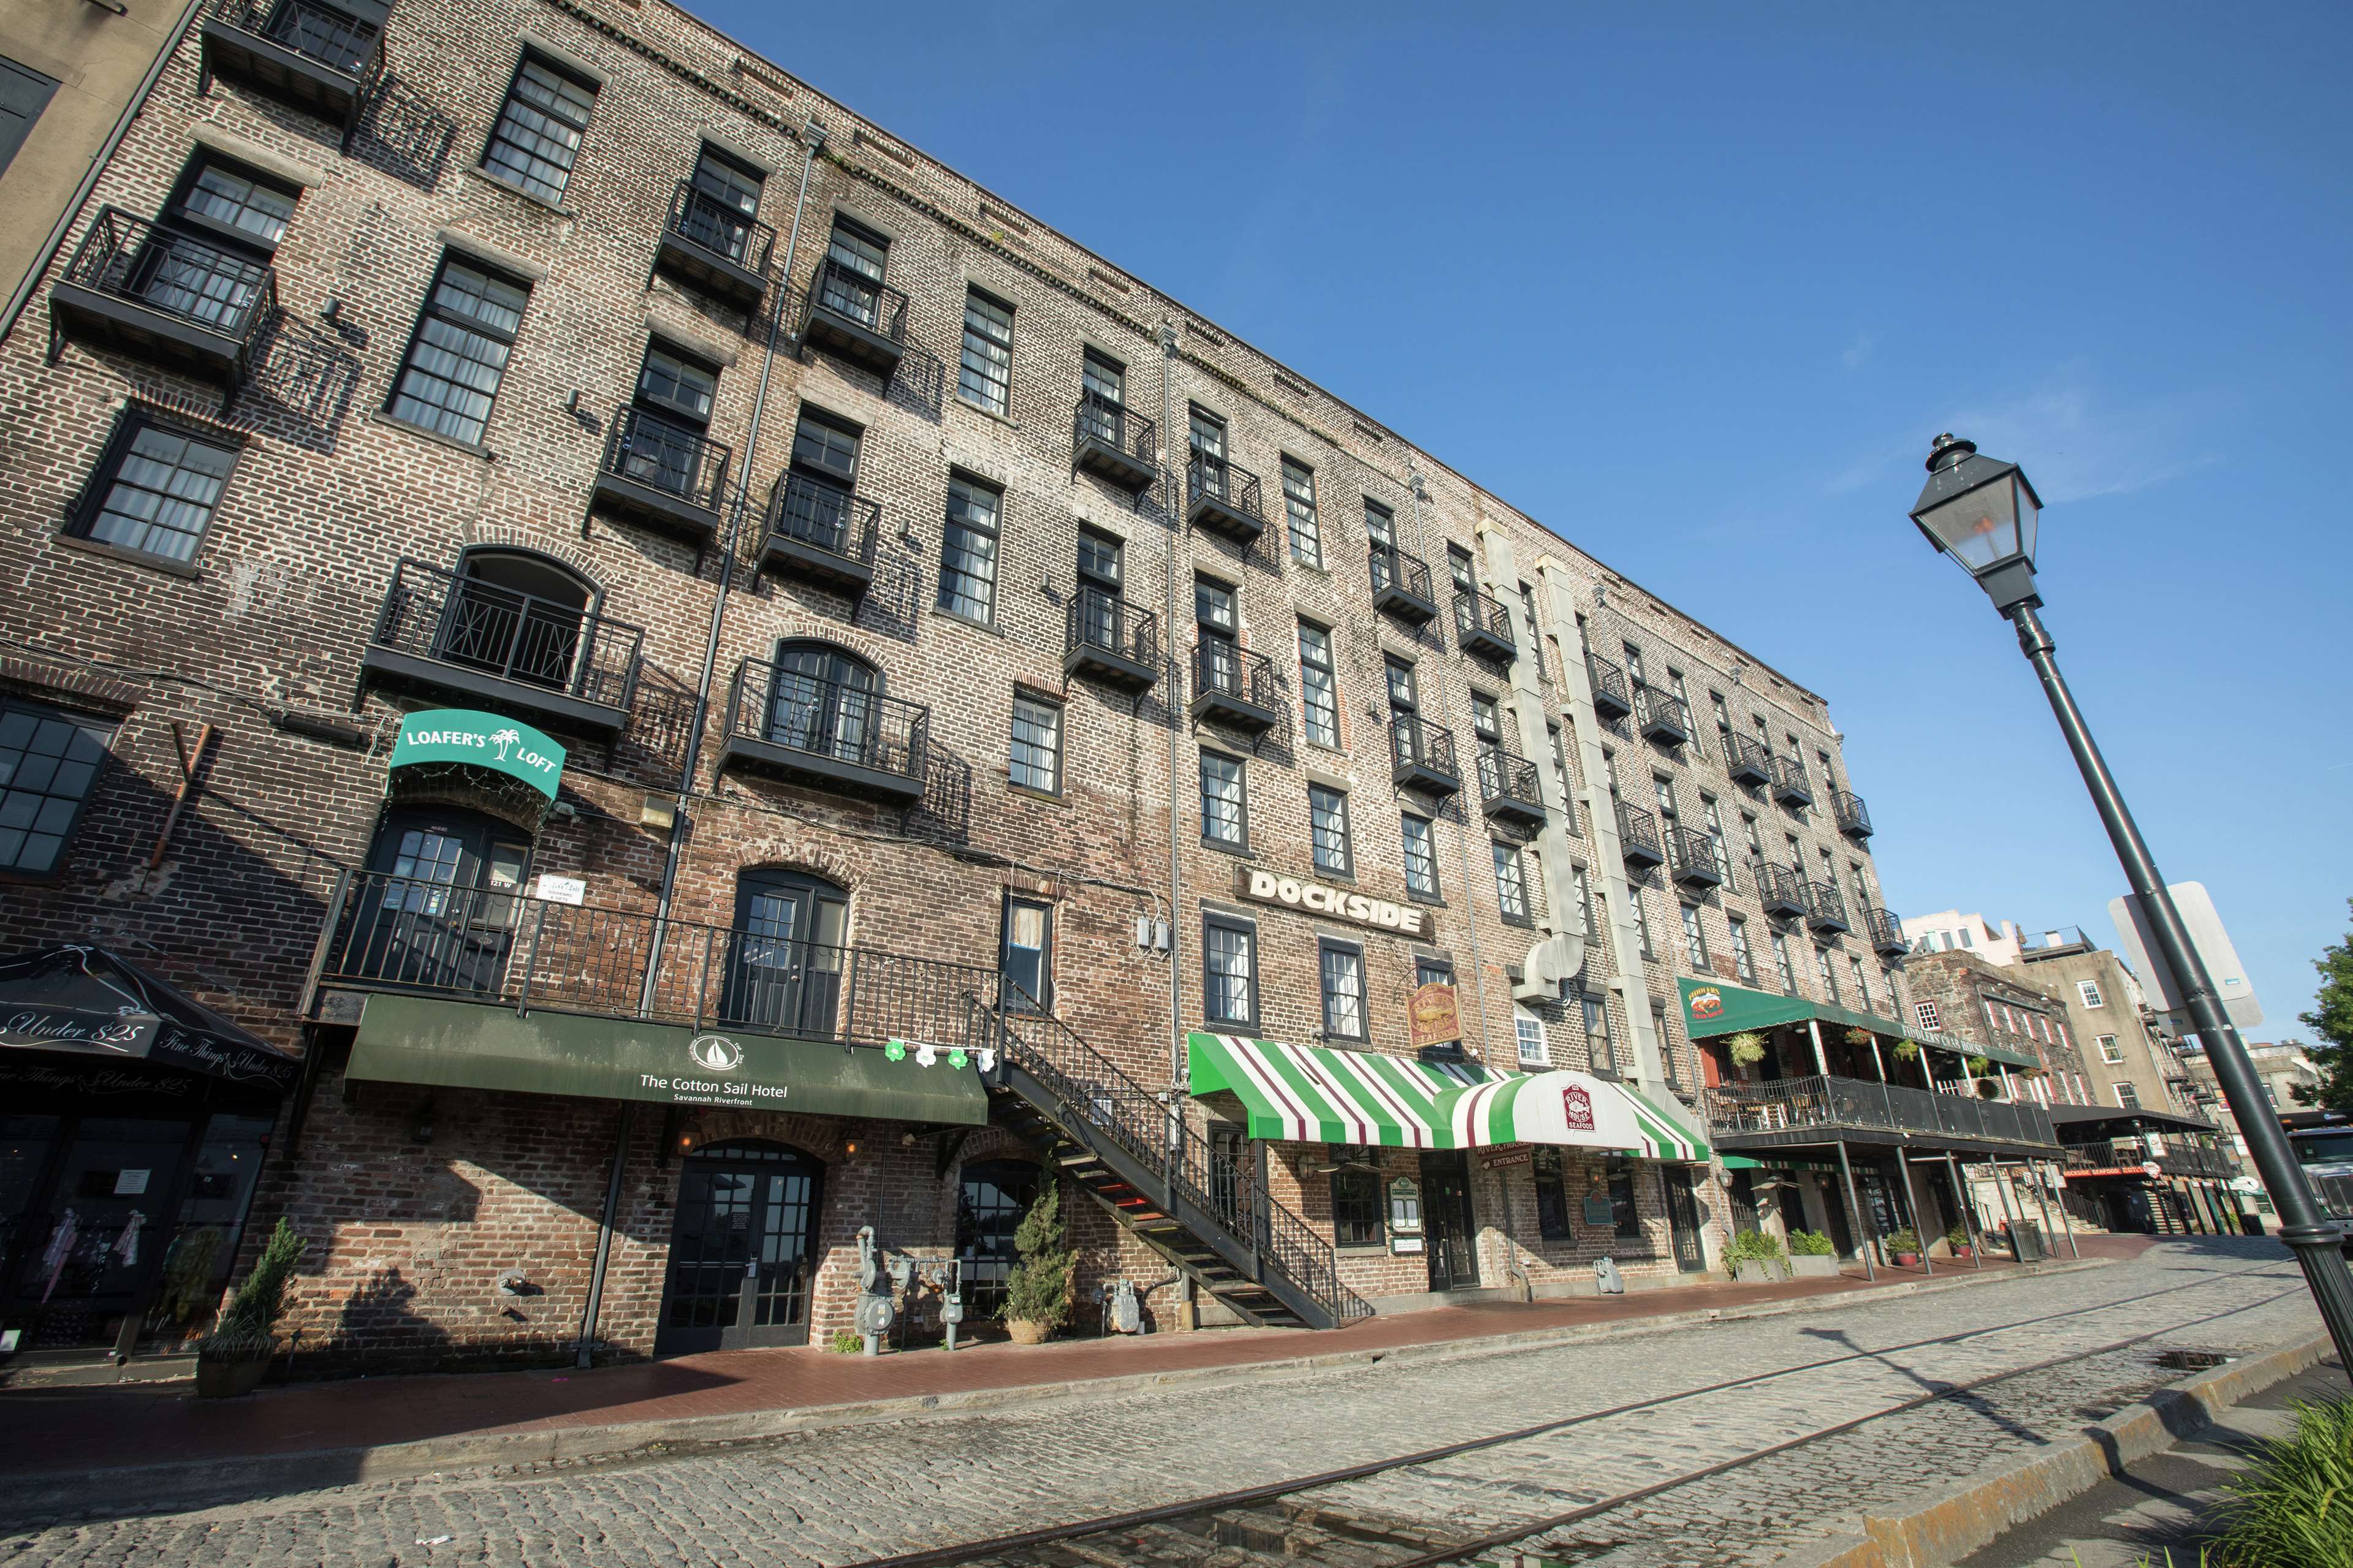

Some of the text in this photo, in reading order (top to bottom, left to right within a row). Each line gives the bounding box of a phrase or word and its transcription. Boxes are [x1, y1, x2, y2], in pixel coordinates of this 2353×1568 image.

[407, 731, 556, 773] LOAFER'S LOFT
[1250, 870, 1421, 933] DOCKSIDE
[1689, 987, 1720, 1001] FIDDLERS
[8, 1011, 145, 1045] Under $25
[1416, 1015, 1453, 1031] HOUSE
[1416, 1028, 1457, 1042] SEAFOOD
[159, 1027, 294, 1078] Fine Things Under $25
[1941, 1035, 1961, 1049] CRAB
[1961, 1040, 1986, 1055] HOUSE
[641, 1074, 788, 1097] The Cotton Sail Hotel
[674, 1094, 753, 1105] Savannah Riverfront
[1566, 1093, 1588, 1106] RIVER
[1569, 1110, 1589, 1121] HOUSE
[1477, 1143, 1503, 1154] RIVER
[1493, 1154, 1529, 1167] ENTRANCE
